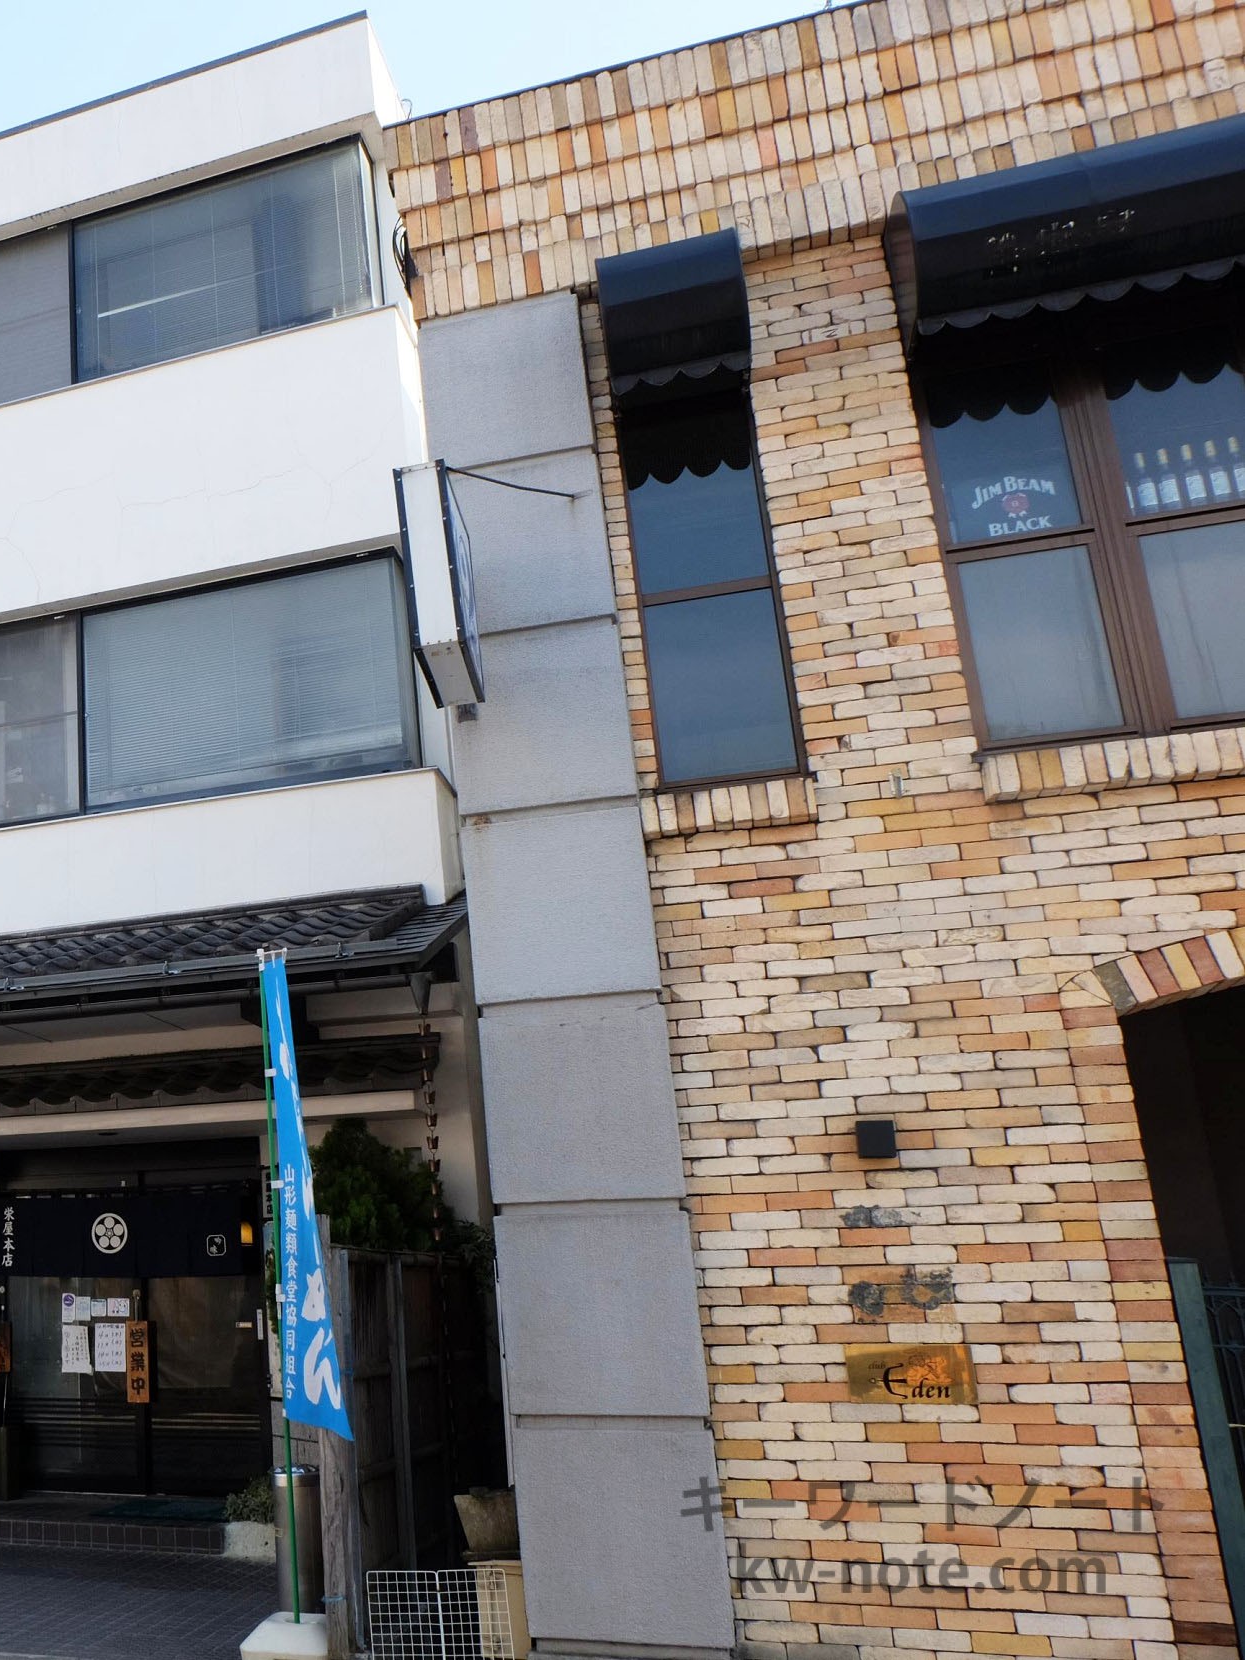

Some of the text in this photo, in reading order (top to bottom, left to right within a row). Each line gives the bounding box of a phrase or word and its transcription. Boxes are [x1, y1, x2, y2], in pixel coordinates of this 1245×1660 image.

[972, 476, 1055, 509] JIM BEAM
[988, 516, 1052, 536] BLACK
[1, 1206, 15, 1267] 栄屋本店
[130, 1328, 146, 1395] 営業中
[882, 1363, 951, 1399] Eden
